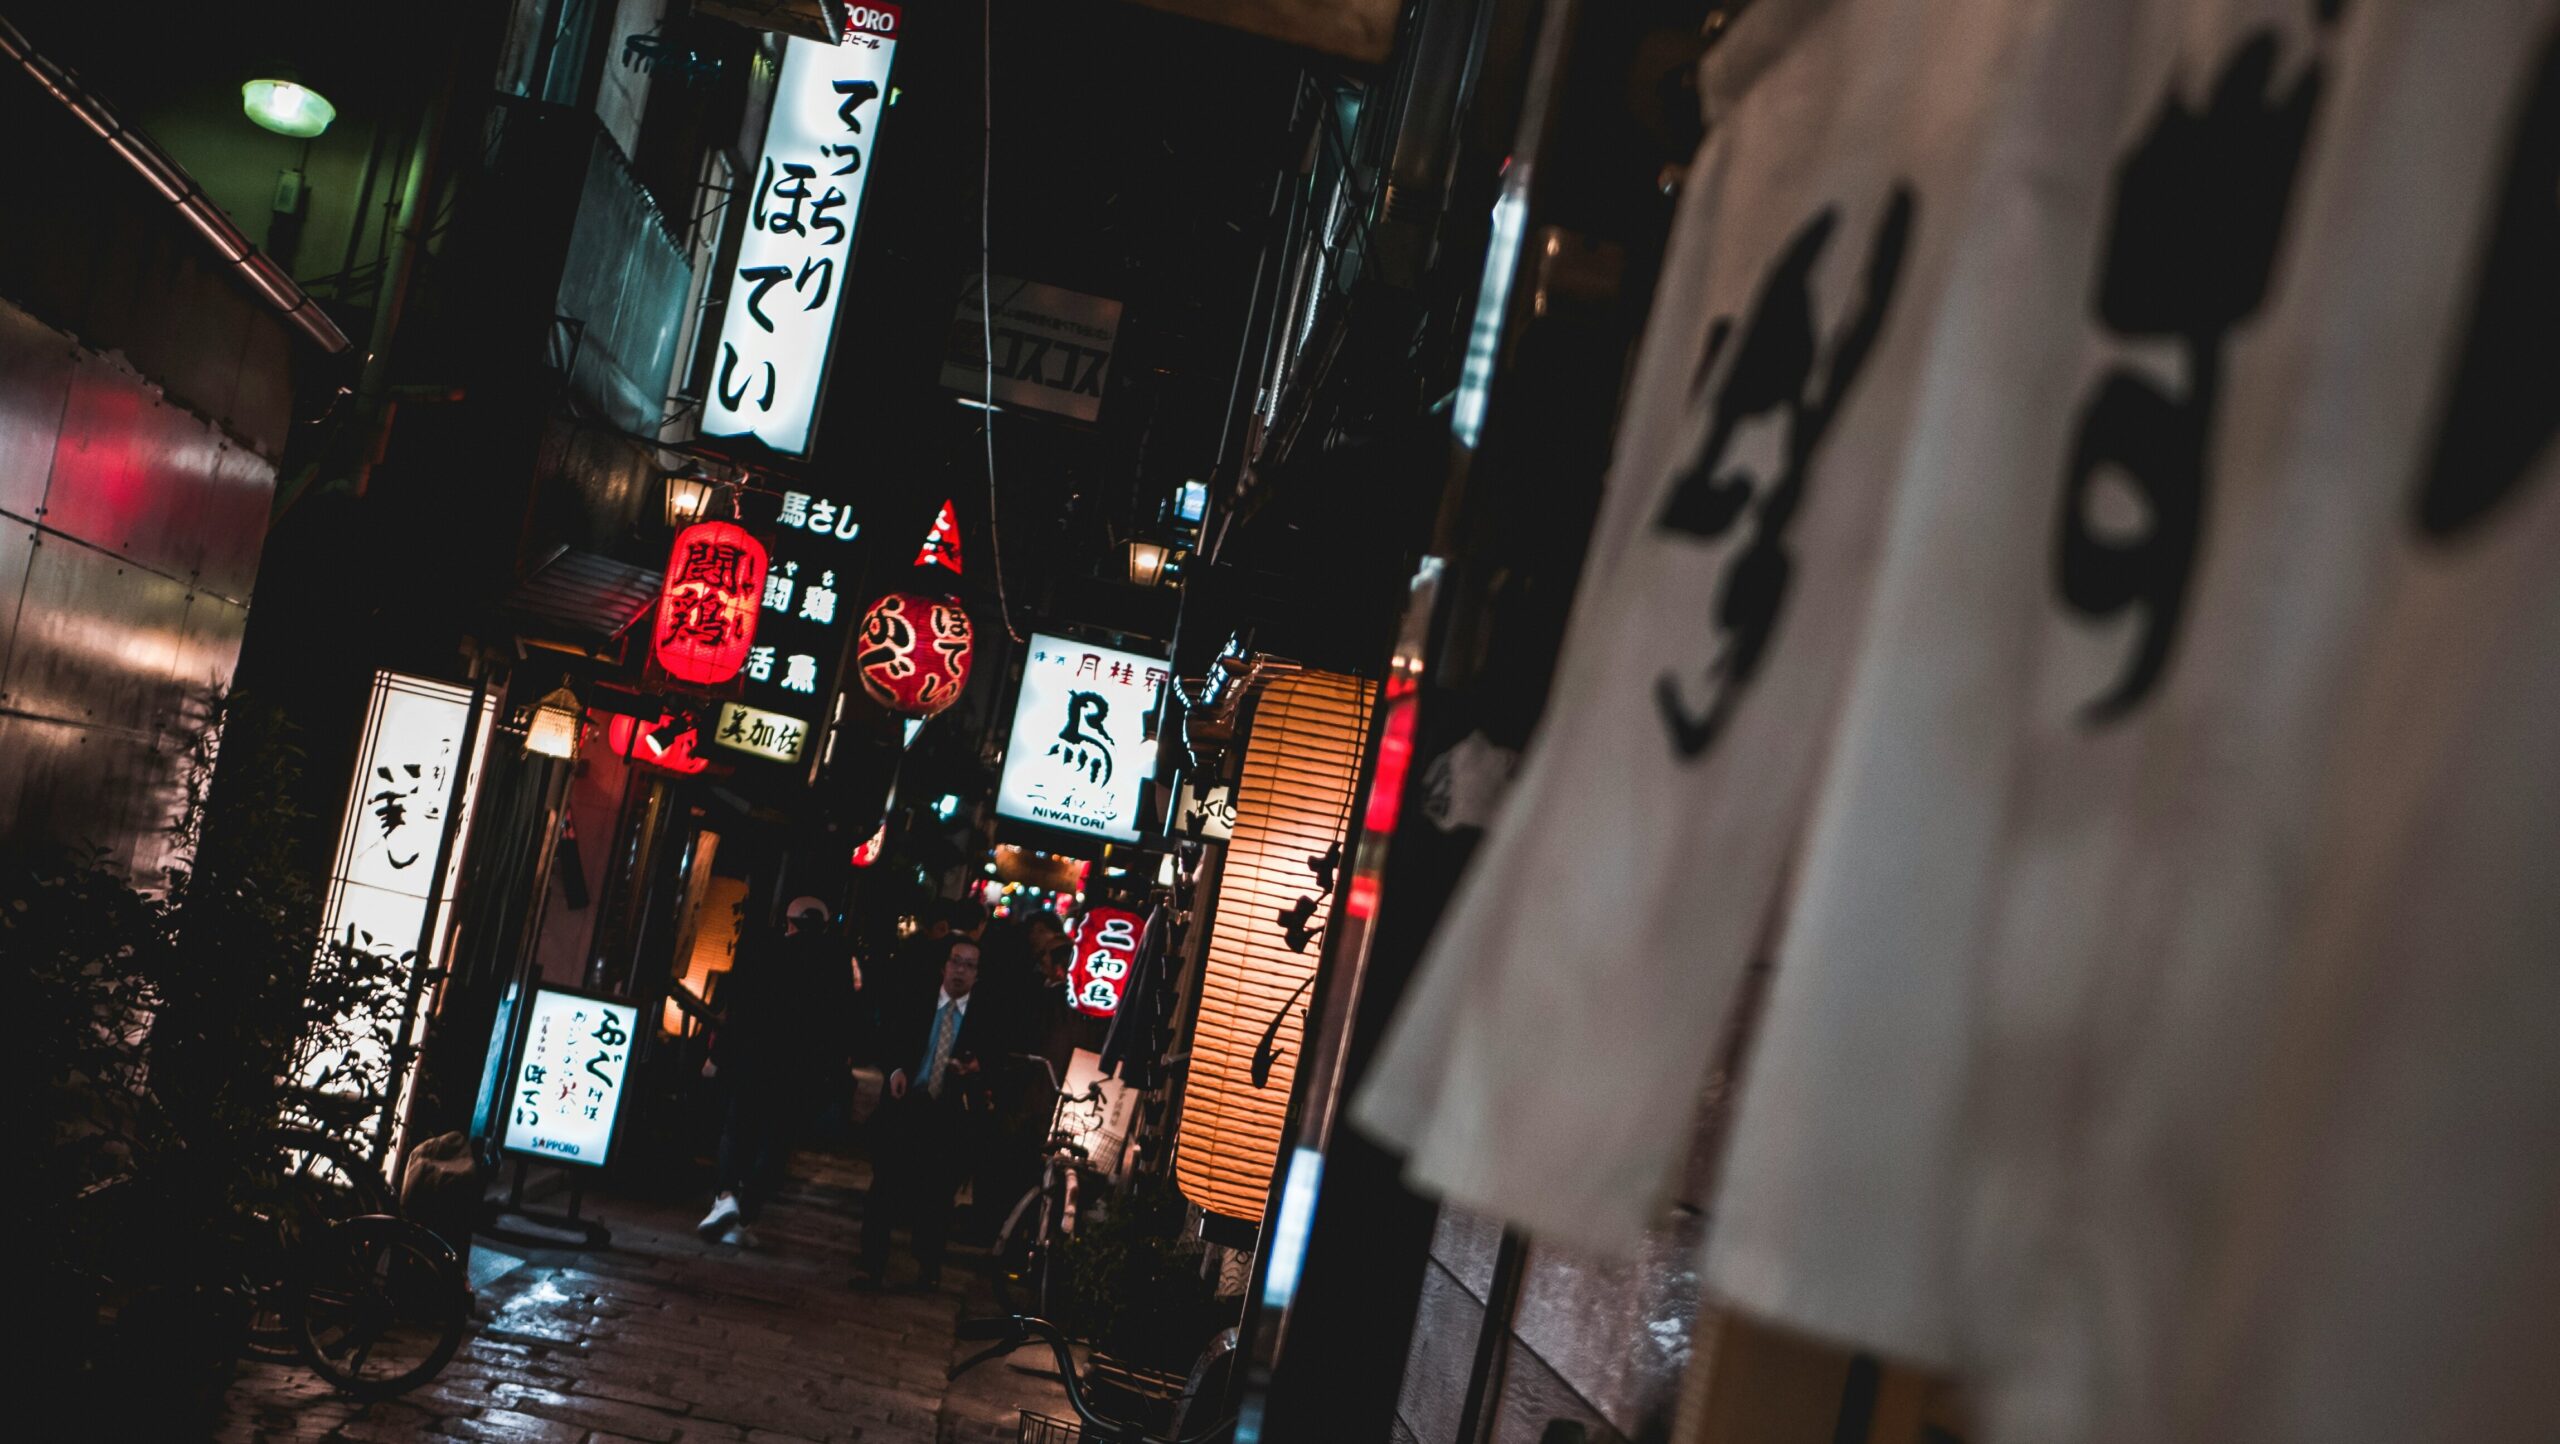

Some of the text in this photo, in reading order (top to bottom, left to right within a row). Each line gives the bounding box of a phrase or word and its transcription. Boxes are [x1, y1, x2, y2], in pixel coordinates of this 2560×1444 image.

[795, 79, 878, 312] てっちり
[718, 157, 817, 413] ほてい
[777, 491, 859, 540] 馬さし
[743, 646, 816, 693] 活魚
[919, 606, 971, 702] ほてい
[719, 709, 802, 755] 美加佐
[1032, 806, 1105, 830] NIWATORI
[515, 1063, 547, 1126] ほてい
[531, 1136, 580, 1156] SAPPORO
